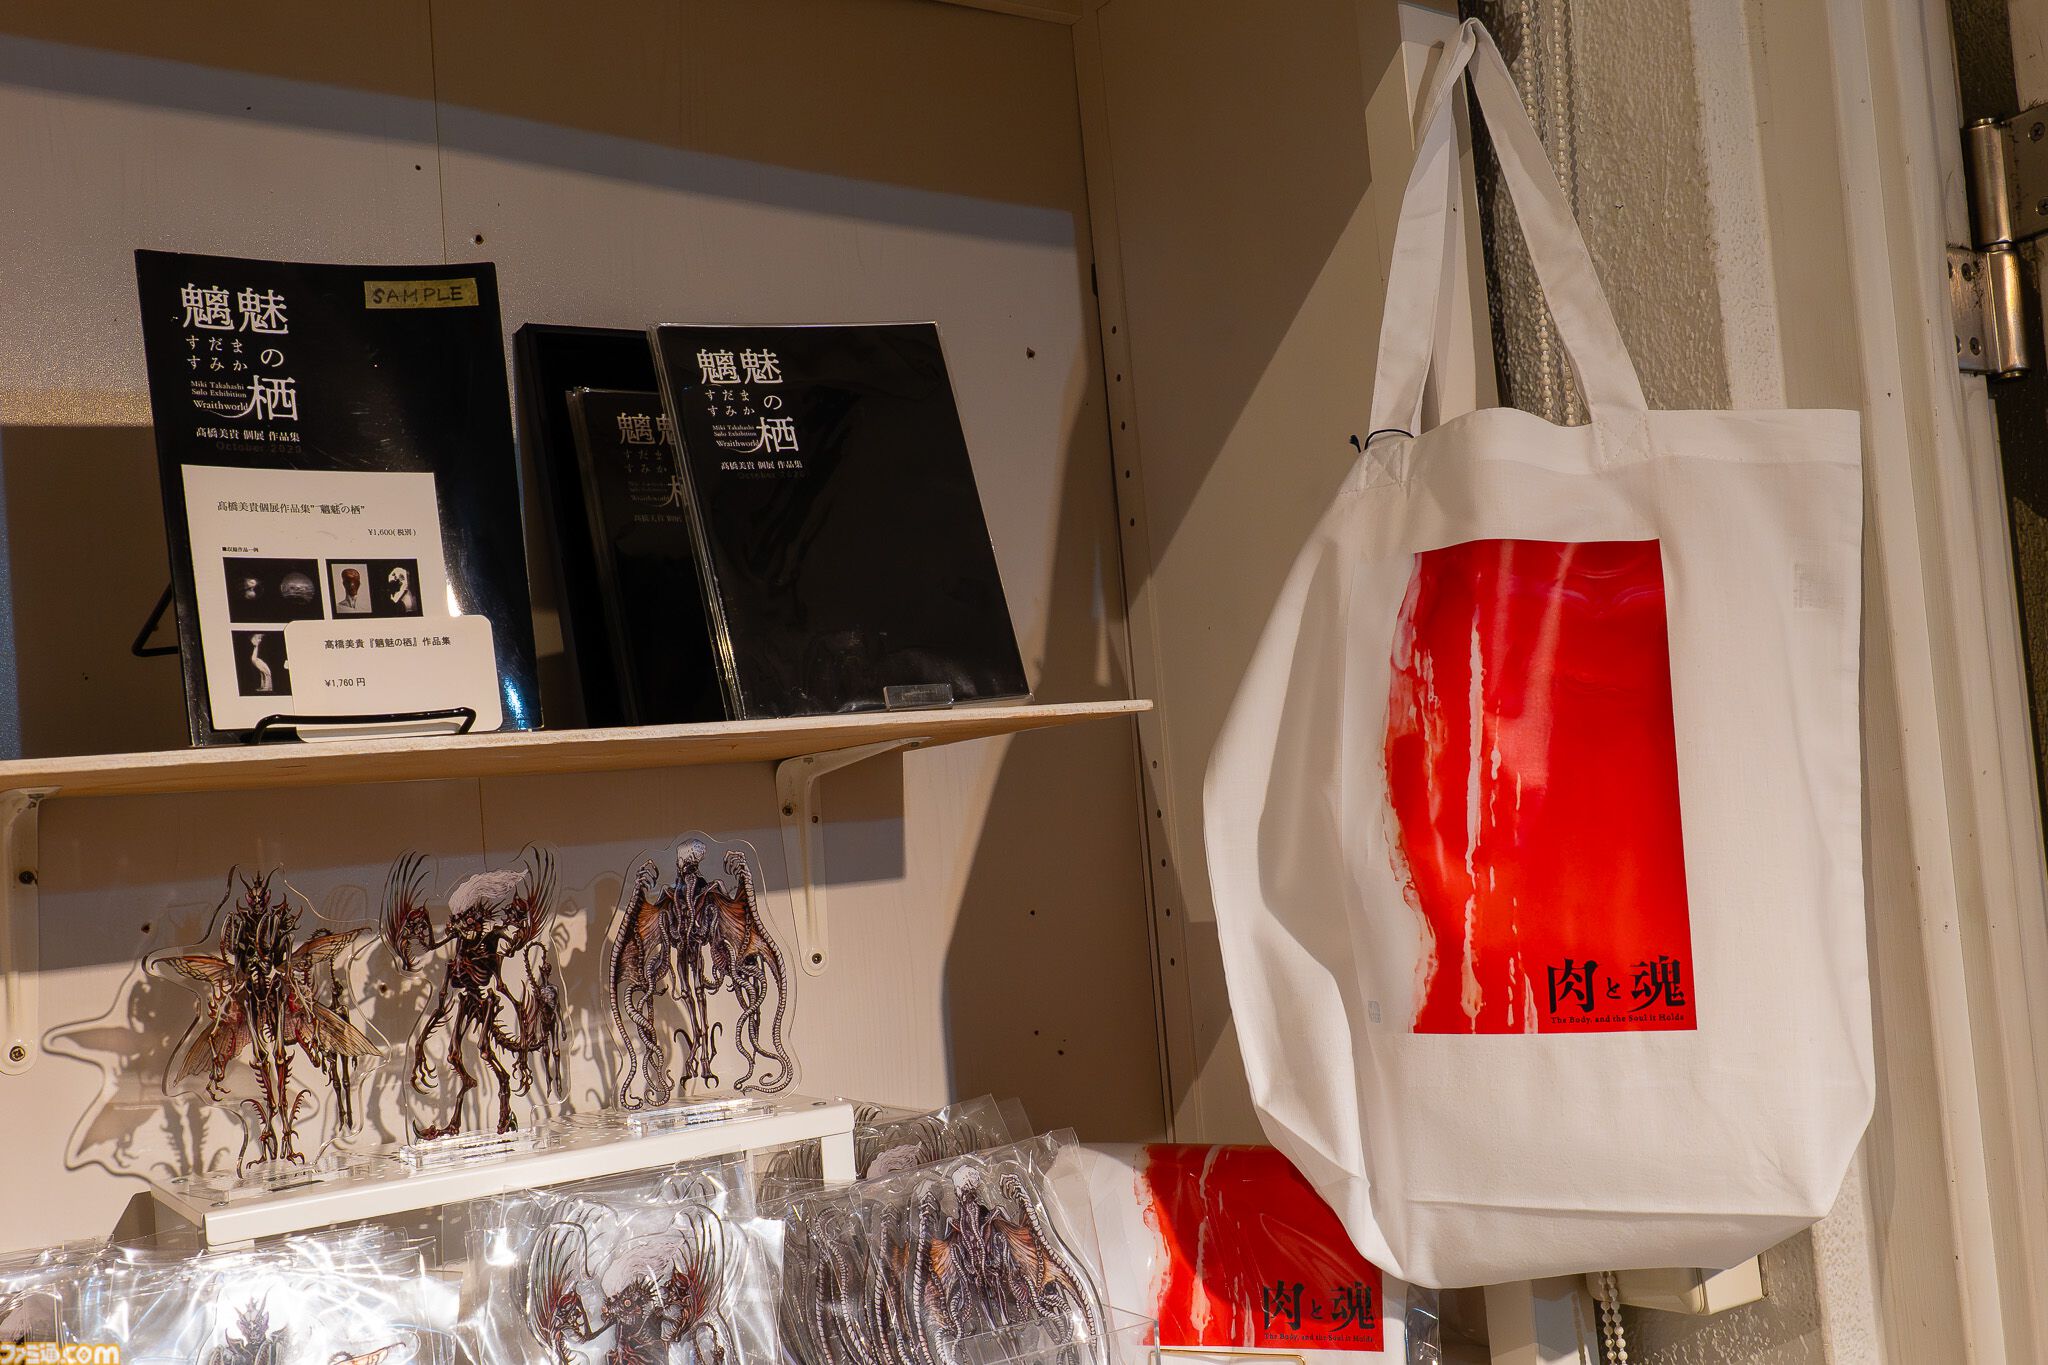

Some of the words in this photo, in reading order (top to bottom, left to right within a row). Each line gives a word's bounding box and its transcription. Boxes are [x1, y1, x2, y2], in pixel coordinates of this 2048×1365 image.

[373, 286, 463, 304] SAMPLE
[180, 283, 289, 334] 魑魅
[696, 349, 784, 385] 魑魅
[209, 382, 245, 390] Takahashi
[210, 390, 247, 398] Exhibition
[193, 400, 249, 411] Wraithworld
[715, 439, 760, 448] Wraithworld
[1547, 955, 1686, 1014] 肉と魂
[1551, 1016, 1567, 1024] The
[1595, 1015, 1610, 1023] and
[1612, 1014, 1626, 1022] the
[1628, 1013, 1647, 1022] Soul
[1649, 1013, 1657, 1021] it
[1658, 1012, 1685, 1021] Holds
[1263, 1279, 1376, 1333] 肉と魂
